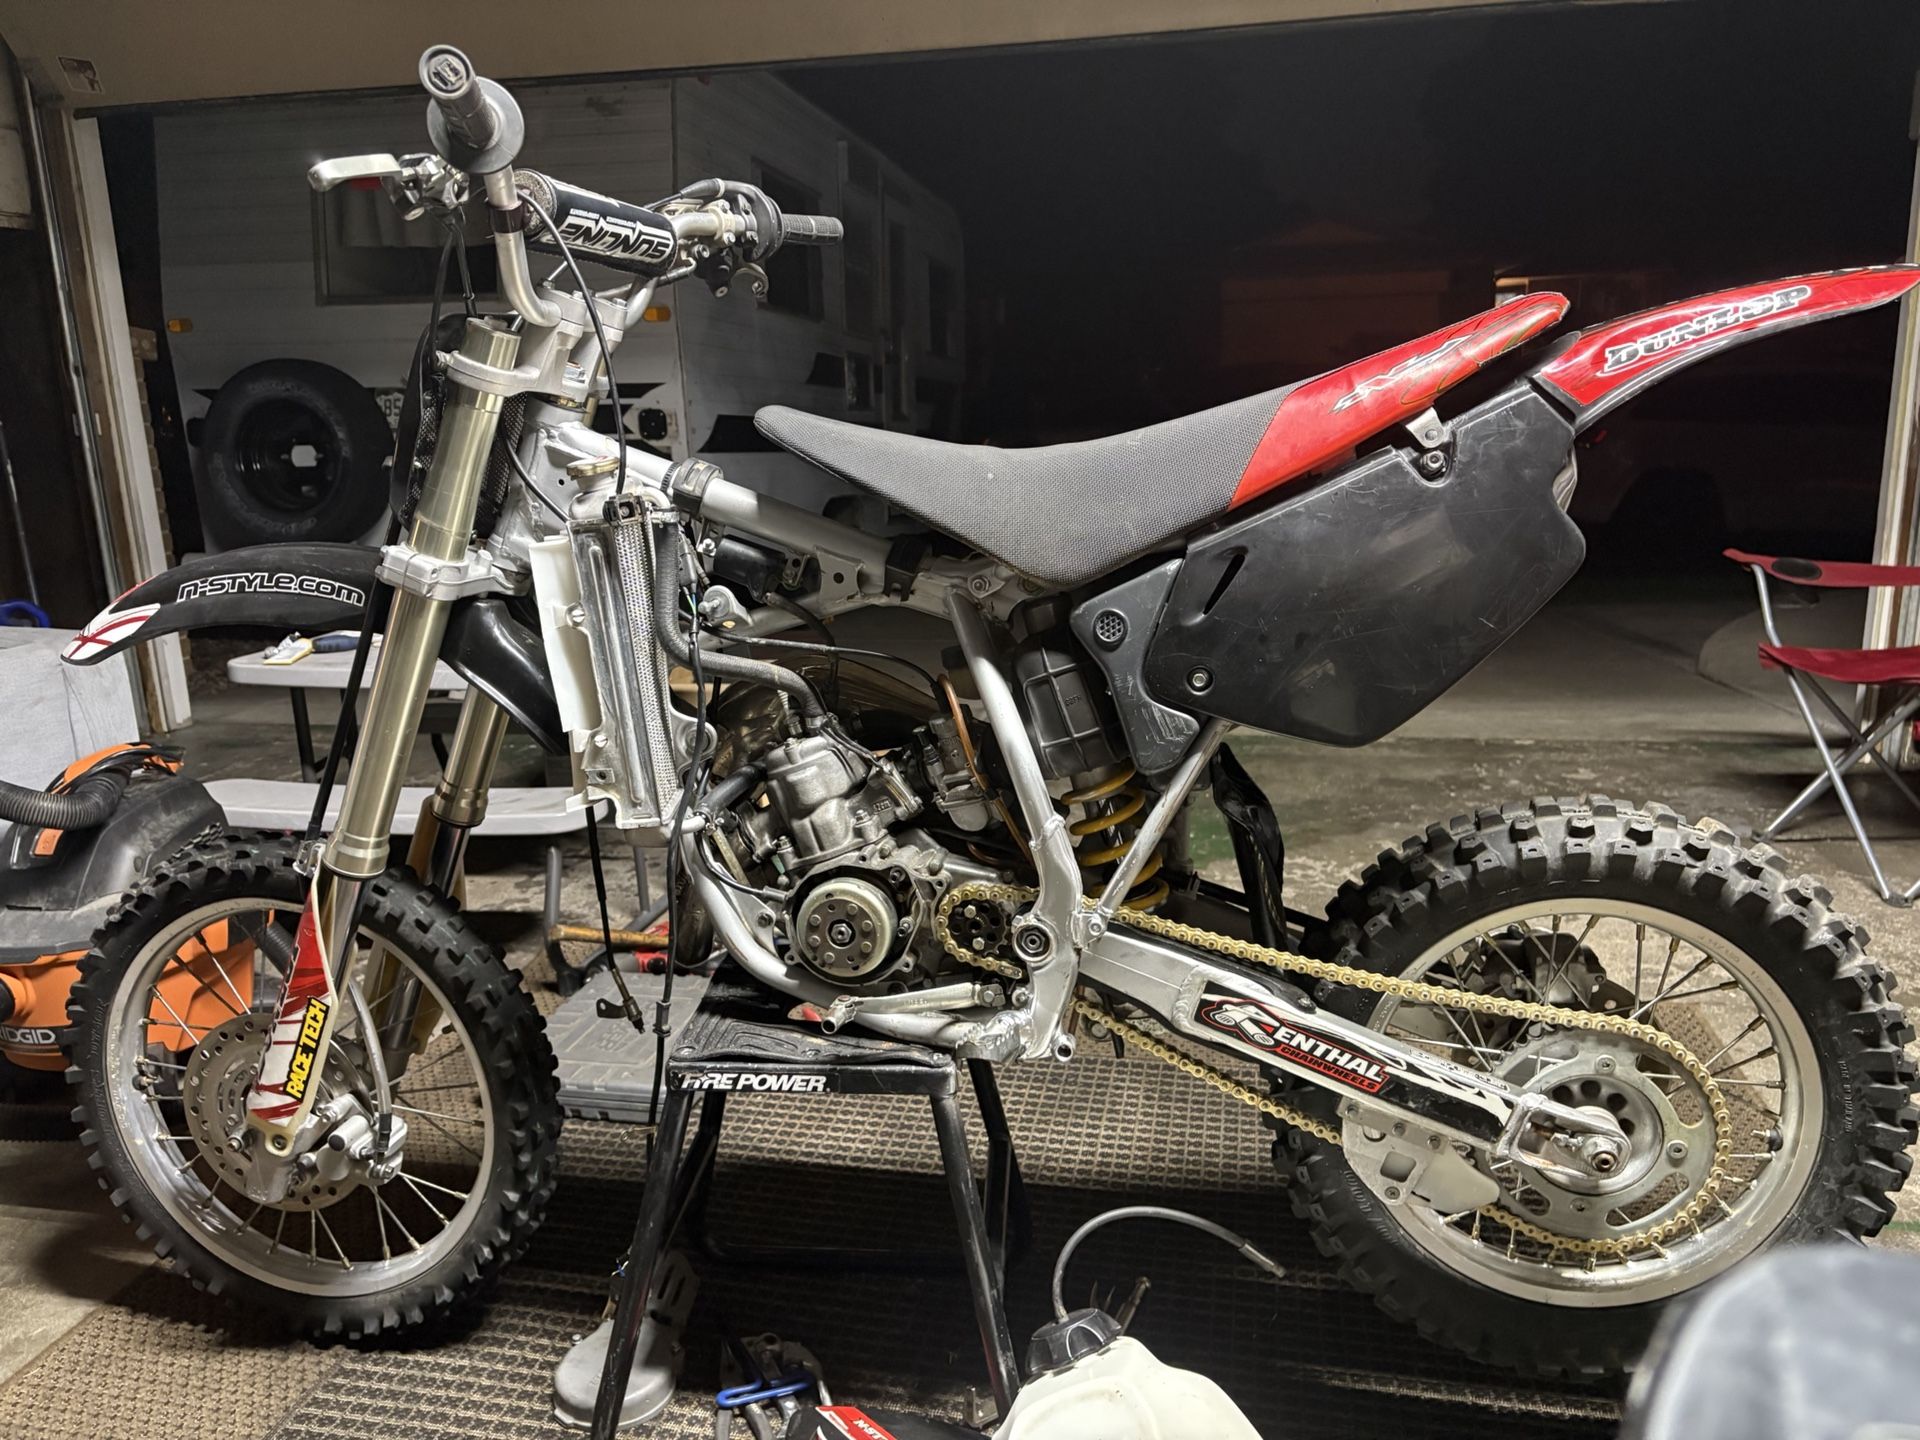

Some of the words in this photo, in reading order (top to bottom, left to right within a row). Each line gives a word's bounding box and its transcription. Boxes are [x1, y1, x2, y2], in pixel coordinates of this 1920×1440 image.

[1604, 285, 1812, 372] DUNLOP
[0, 1025, 56, 1044] IDGID
[286, 1046, 314, 1099] RACE
[302, 997, 328, 1050] TECH
[680, 1072, 739, 1090] FIRE
[736, 1073, 827, 1092] POWER
[1279, 1045, 1379, 1091] CHAINWHEELS
